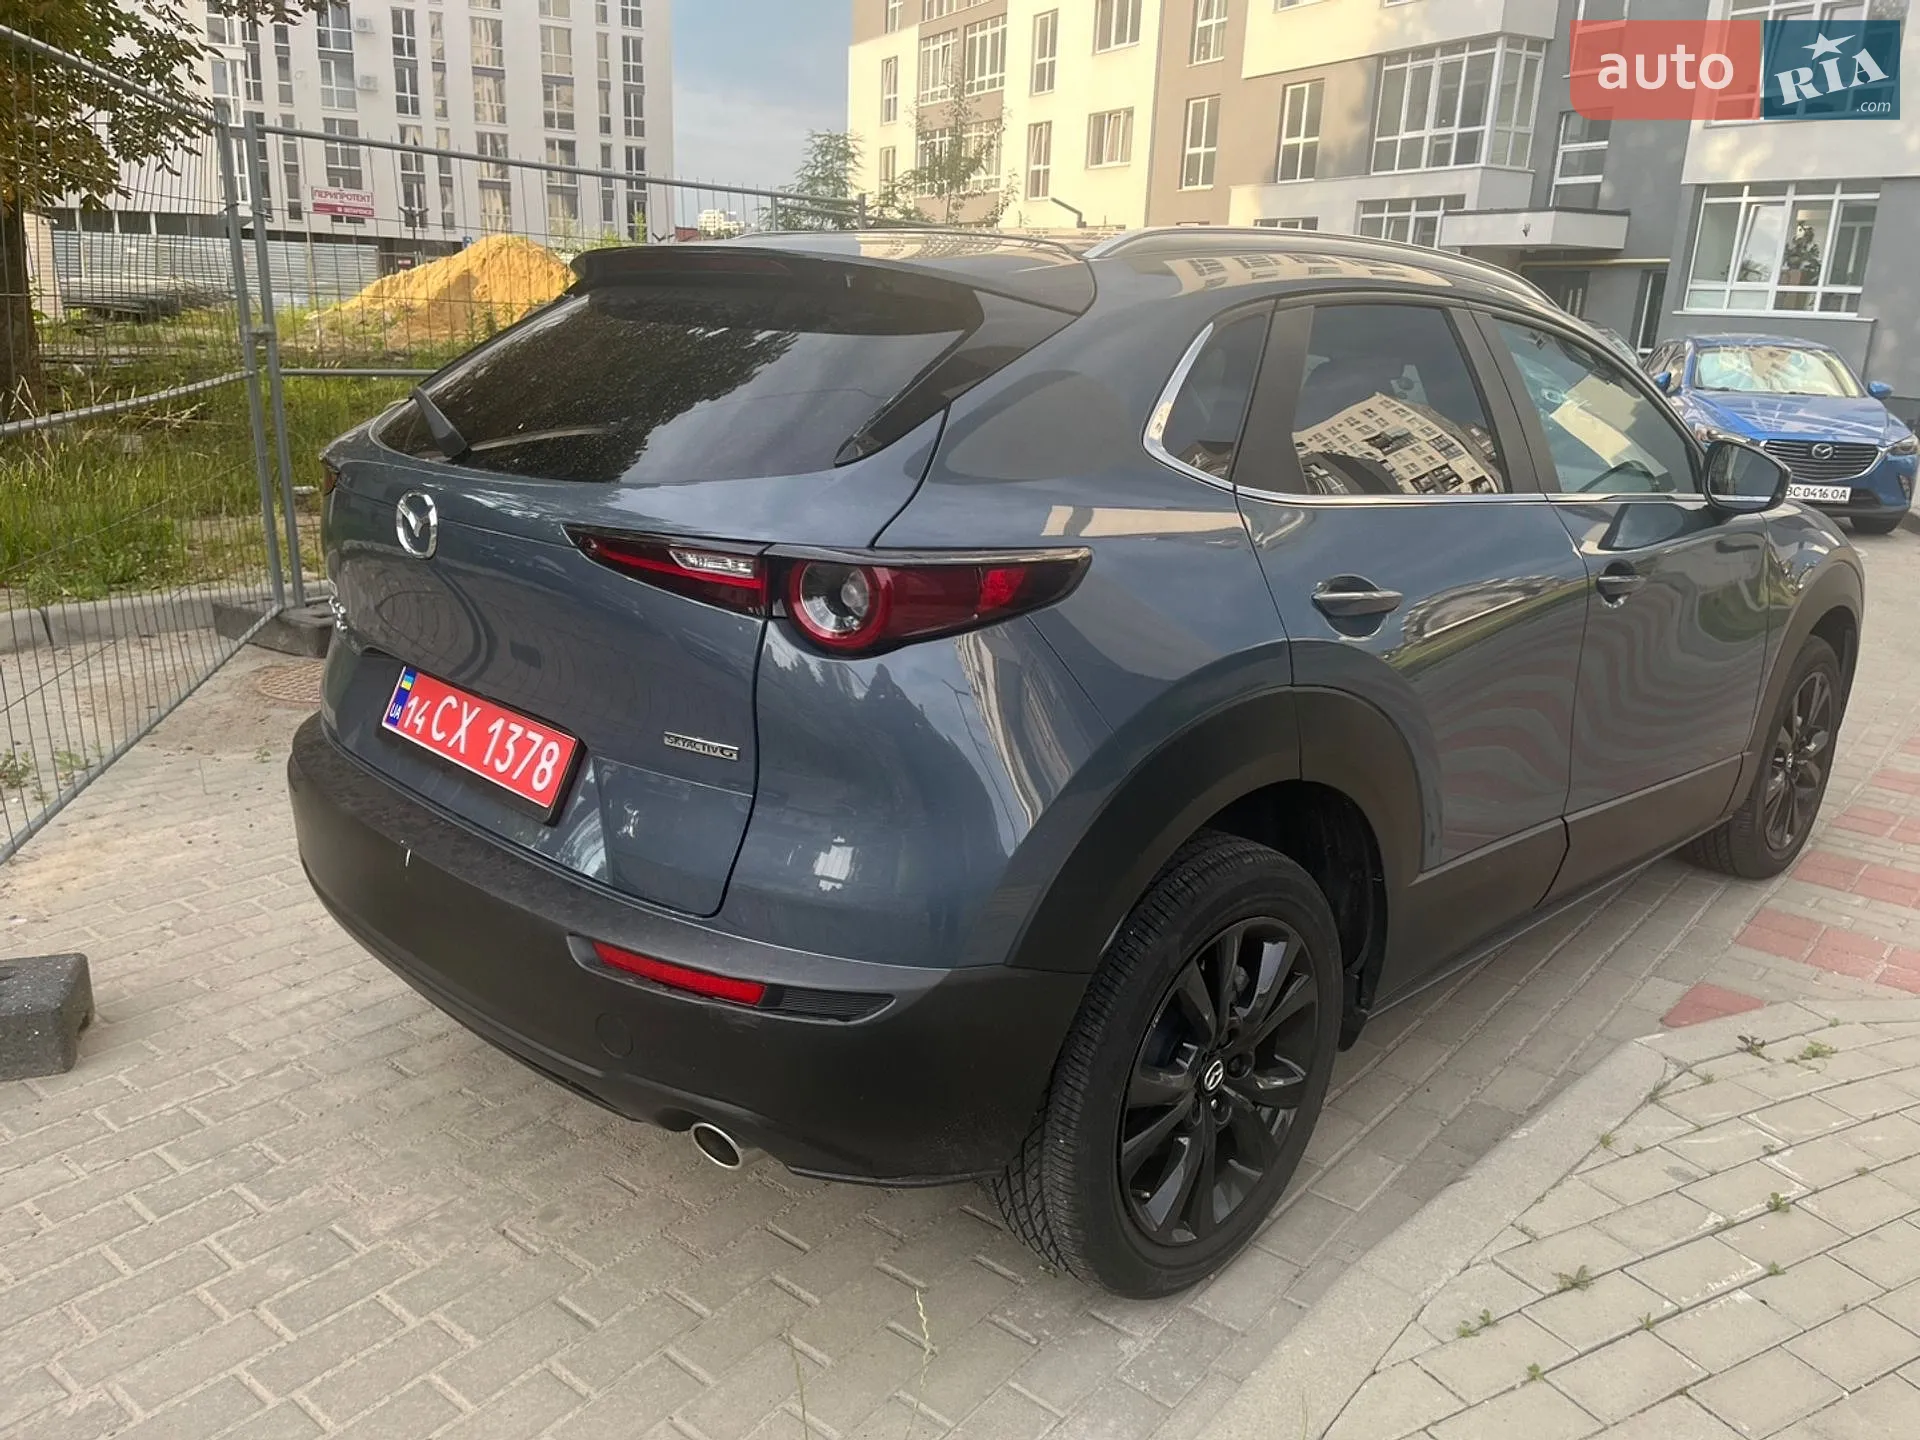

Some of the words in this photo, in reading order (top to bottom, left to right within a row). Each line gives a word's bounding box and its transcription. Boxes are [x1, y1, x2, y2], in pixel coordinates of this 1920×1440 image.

[1803, 487, 1830, 499] 0416
[1831, 489, 1848, 500] OA
[389, 703, 402, 720] UA
[483, 717, 561, 793] 1378
